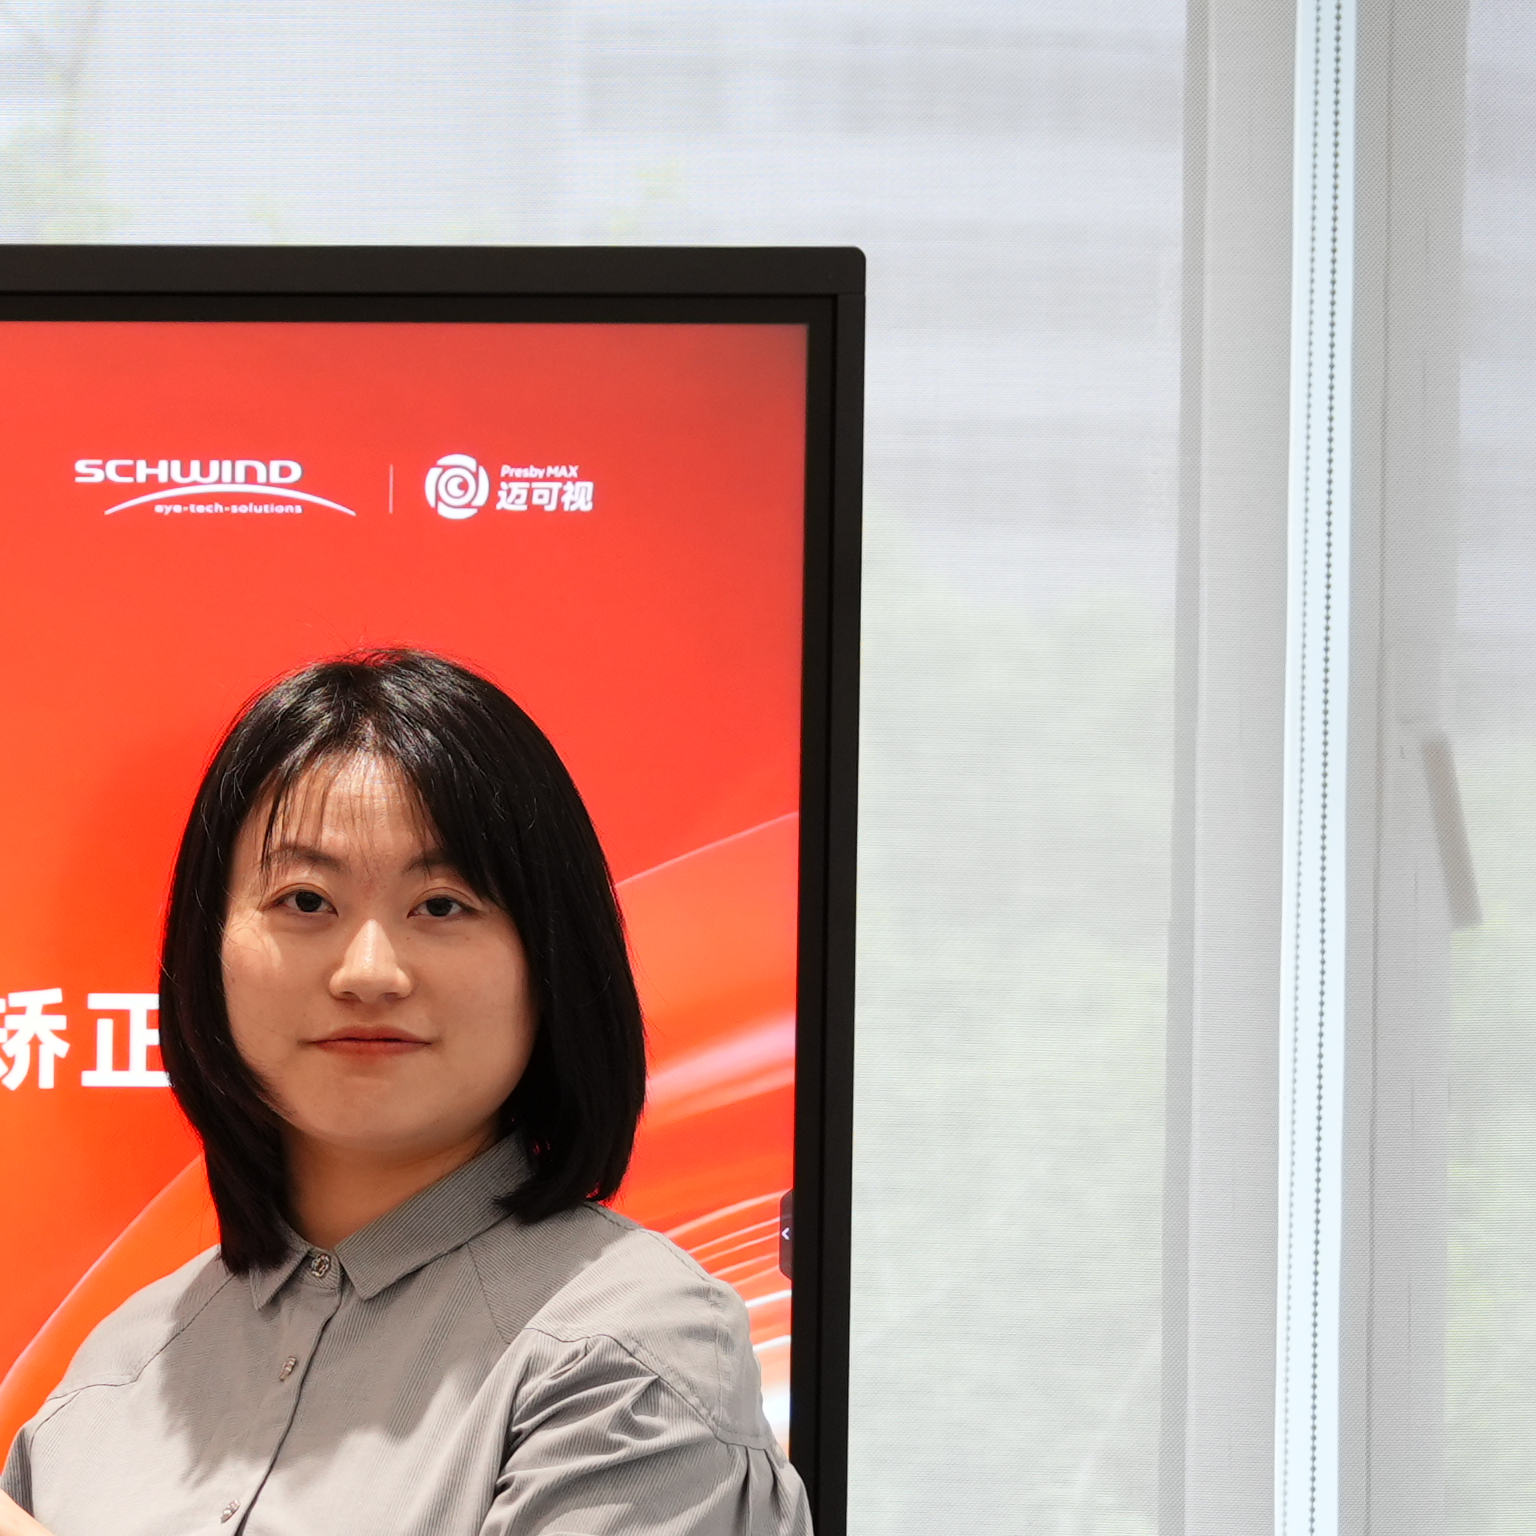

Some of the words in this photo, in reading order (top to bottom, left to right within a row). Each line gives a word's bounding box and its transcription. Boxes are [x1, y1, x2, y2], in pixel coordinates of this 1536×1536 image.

[74, 459, 302, 483] SCHWIND
[496, 481, 595, 511] 迈可视
